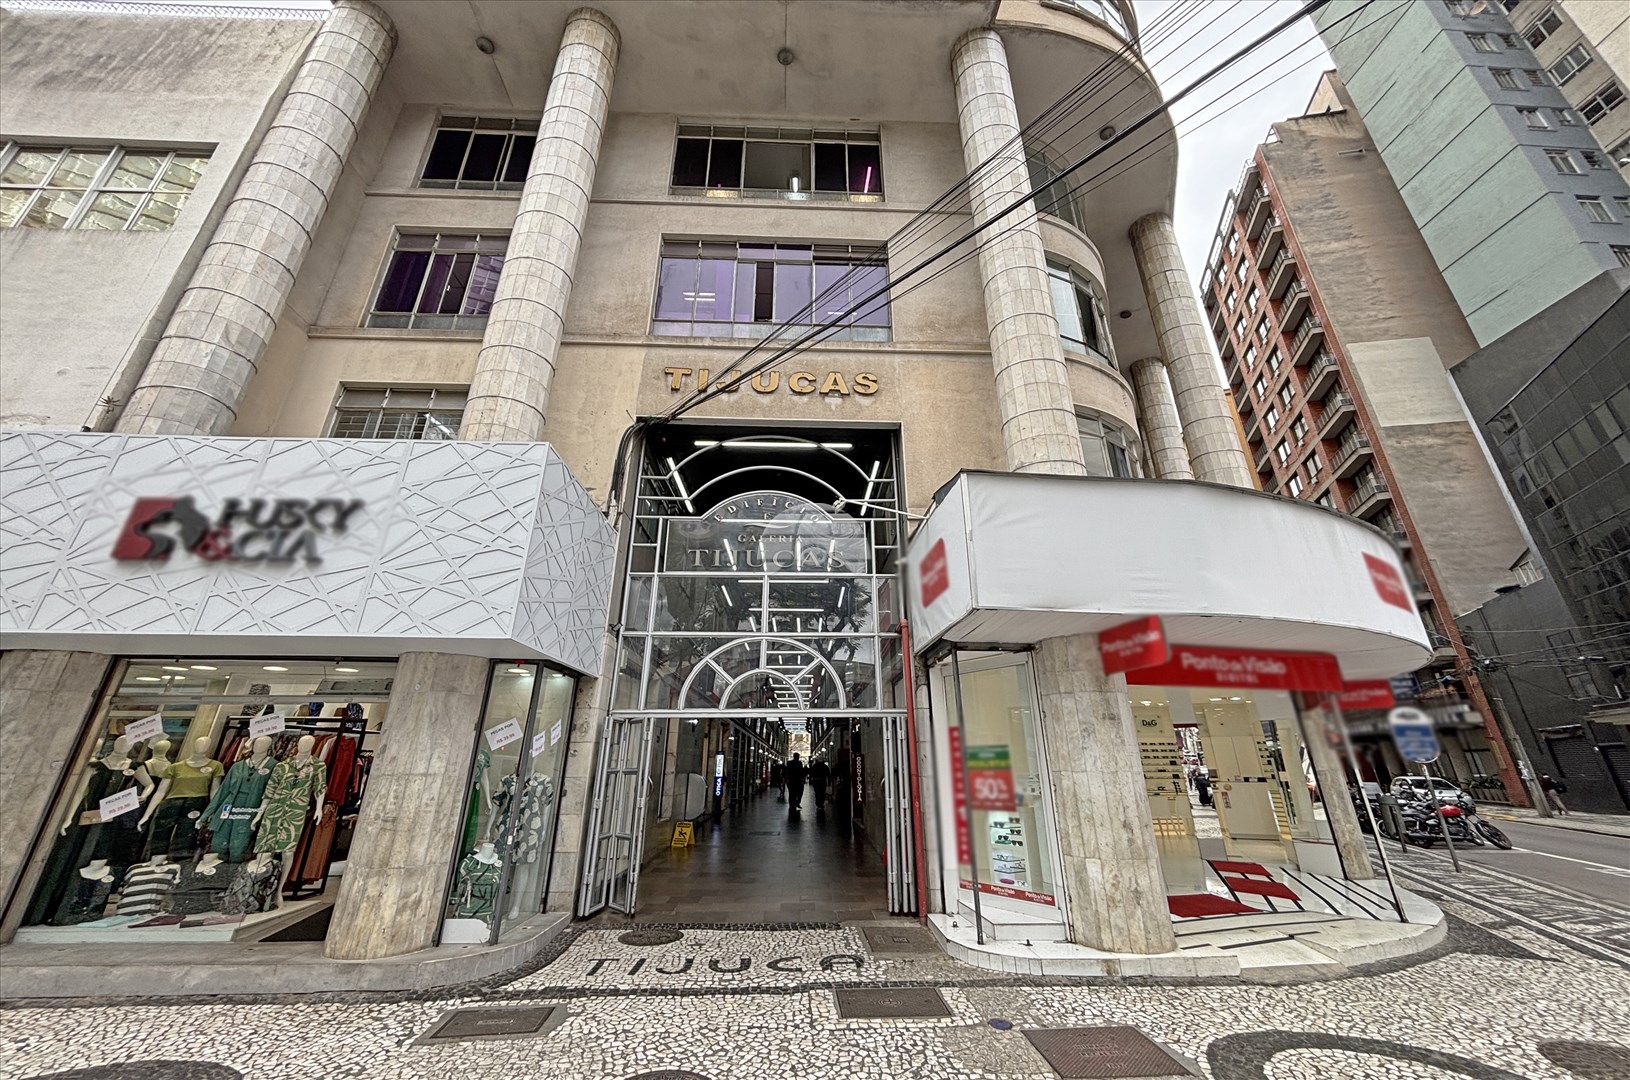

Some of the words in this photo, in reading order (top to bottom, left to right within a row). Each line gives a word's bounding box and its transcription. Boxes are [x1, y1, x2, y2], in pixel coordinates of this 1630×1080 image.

[665, 366, 880, 396] TIJUCAS
[737, 534, 804, 544] GALERIA
[688, 549, 847, 569] TIJUCAS
[1141, 719, 1158, 727] D&G
[585, 953, 865, 977] TIJUCA
